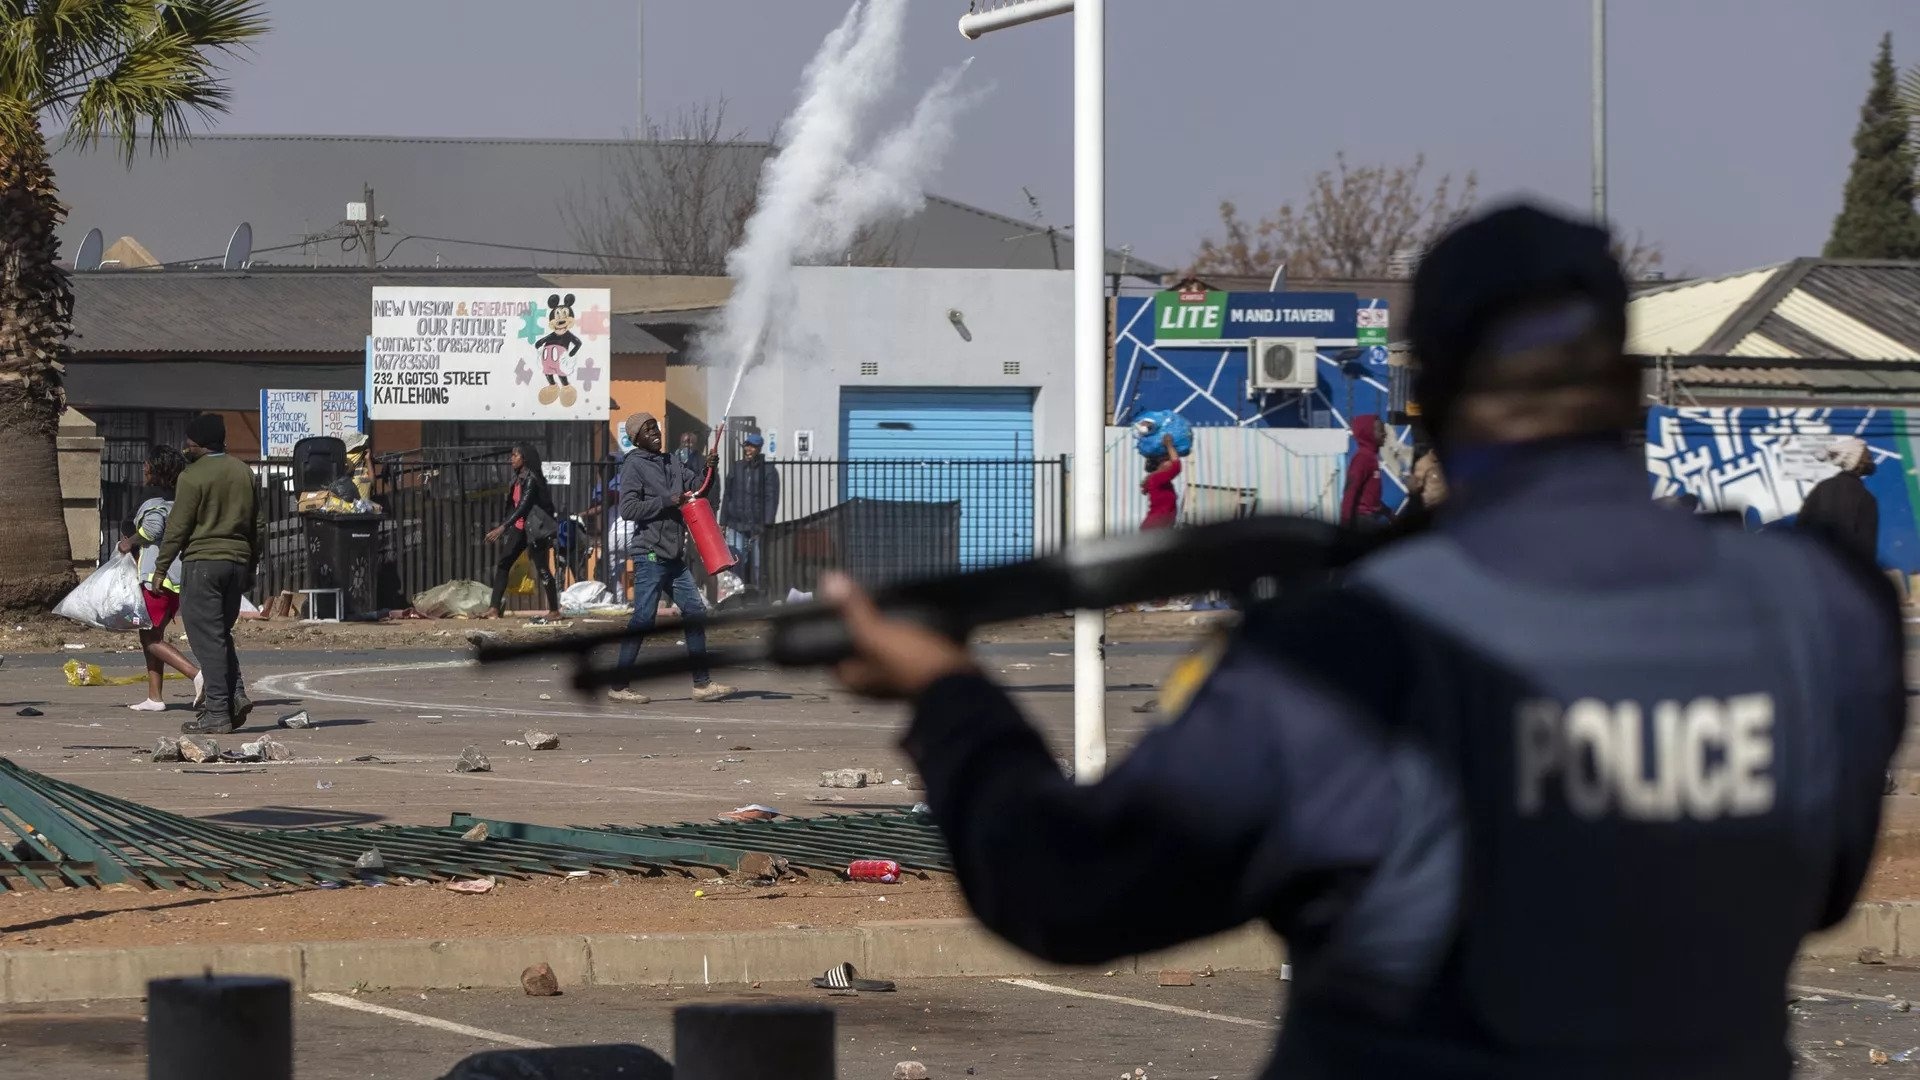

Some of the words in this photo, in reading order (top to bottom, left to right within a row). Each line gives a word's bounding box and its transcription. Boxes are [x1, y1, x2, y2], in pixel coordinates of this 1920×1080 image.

[374, 300, 405, 317] NEW
[408, 300, 454, 316] VISION
[456, 301, 469, 317] &
[471, 301, 532, 317] GENERATION
[1161, 305, 1219, 329] LITE
[1283, 309, 1335, 322] TAVERN
[417, 317, 448, 337] OUR
[450, 318, 507, 337] FUTURE
[373, 372, 394, 386] 232
[397, 371, 439, 386] KGOTSO
[443, 371, 491, 386] STREET
[270, 391, 318, 402] INTERNET
[373, 386, 450, 405] KATLEHONG
[270, 402, 286, 412] FAX
[1516, 694, 1774, 820] POLICE
